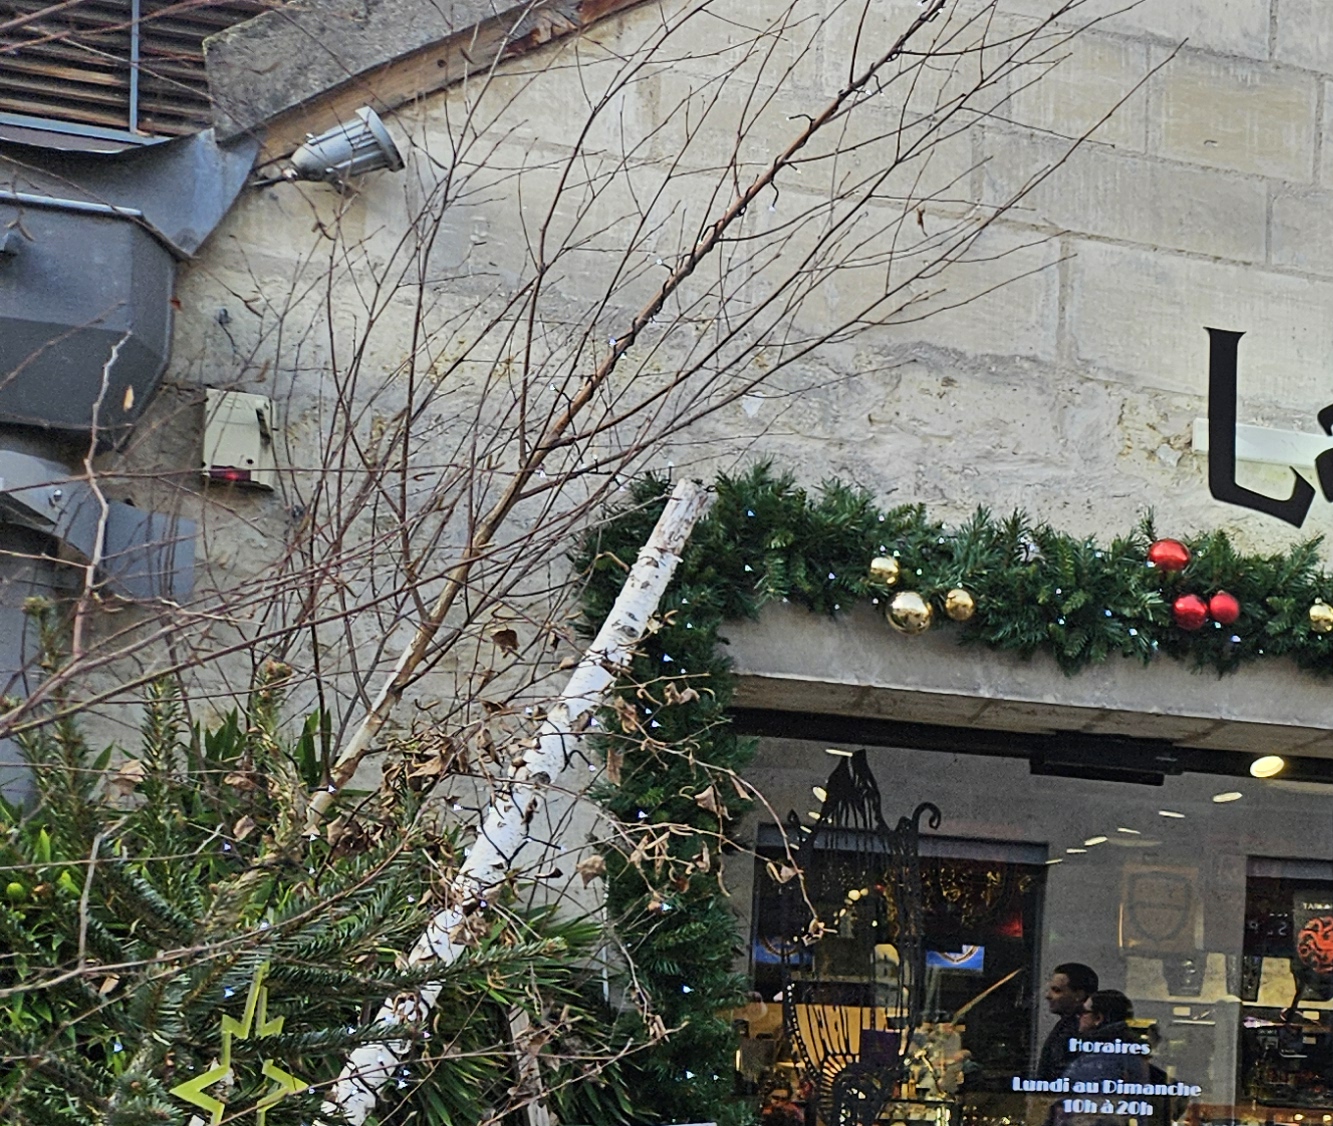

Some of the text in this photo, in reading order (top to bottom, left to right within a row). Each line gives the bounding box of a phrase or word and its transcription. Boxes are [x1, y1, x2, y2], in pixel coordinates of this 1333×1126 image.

[1069, 1038, 1151, 1055] Horaires
[1012, 1077, 1202, 1097] Lundi au Dimanche
[1063, 1099, 1154, 1116] 10h à 20h
